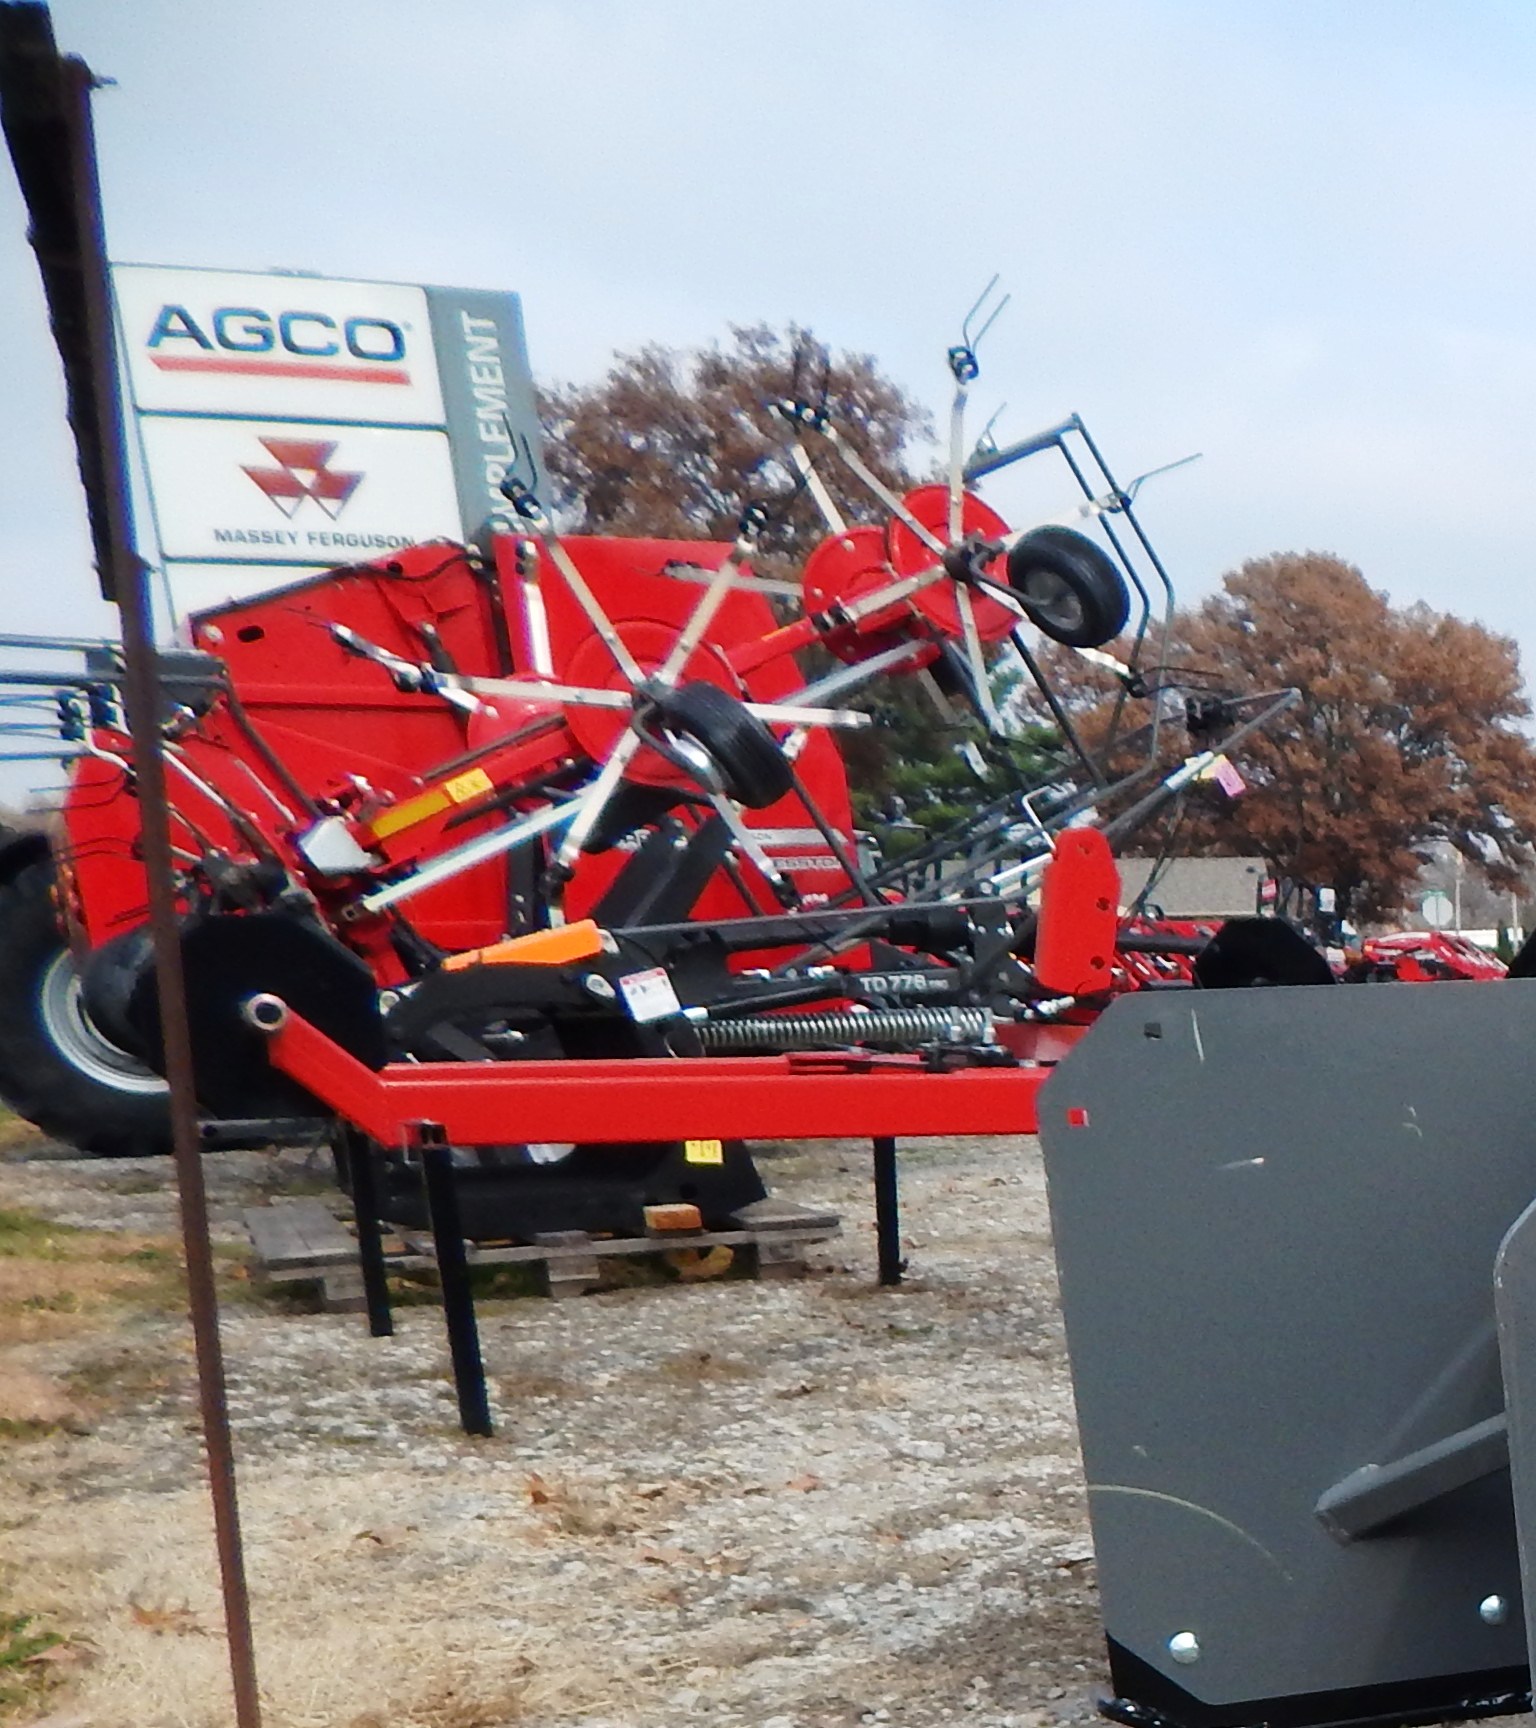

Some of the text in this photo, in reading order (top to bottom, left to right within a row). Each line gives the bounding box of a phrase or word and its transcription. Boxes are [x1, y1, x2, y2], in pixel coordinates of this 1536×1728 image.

[147, 304, 406, 362] AGCO
[214, 528, 415, 549] MASSEY FERGUSON
